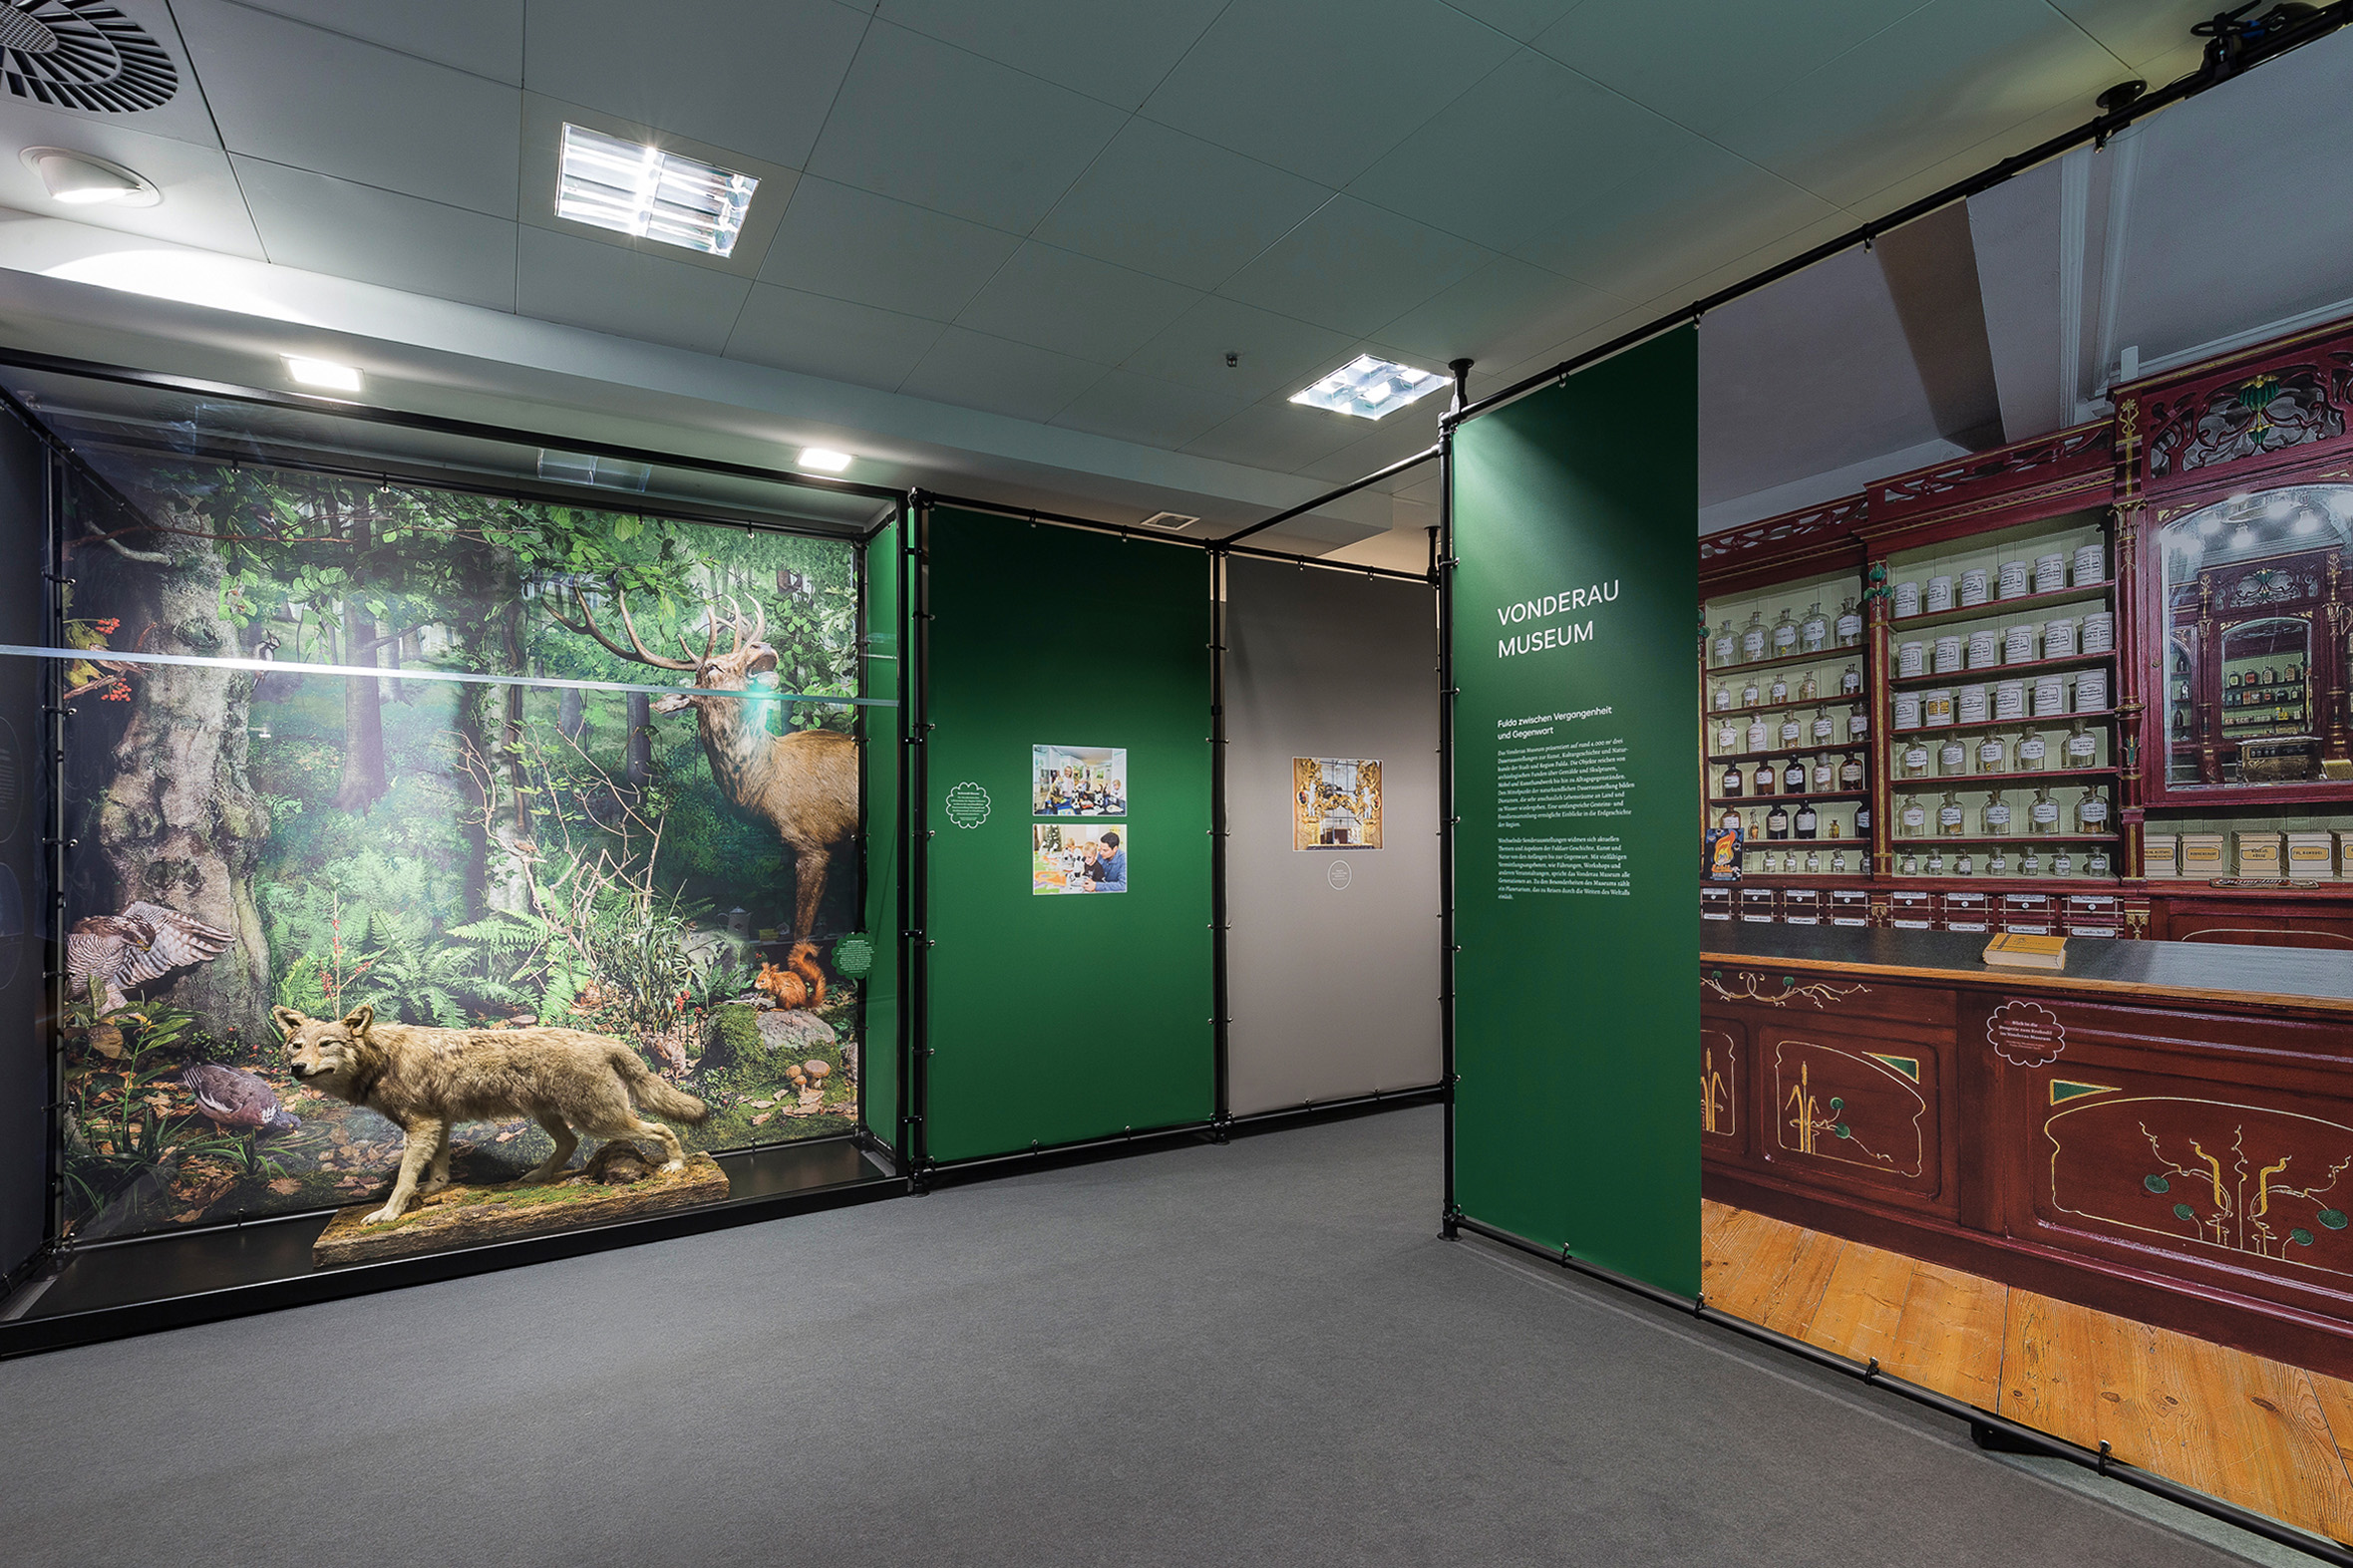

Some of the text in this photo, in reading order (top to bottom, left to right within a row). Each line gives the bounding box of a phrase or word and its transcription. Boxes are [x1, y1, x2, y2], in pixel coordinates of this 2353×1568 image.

[1498, 580, 1618, 625] VONDERAU
[1499, 621, 1592, 658] MUSEUM
[1498, 706, 1612, 728] Fulda zwischen Vergangenheit
[1513, 727, 1554, 739] Gegenwart
